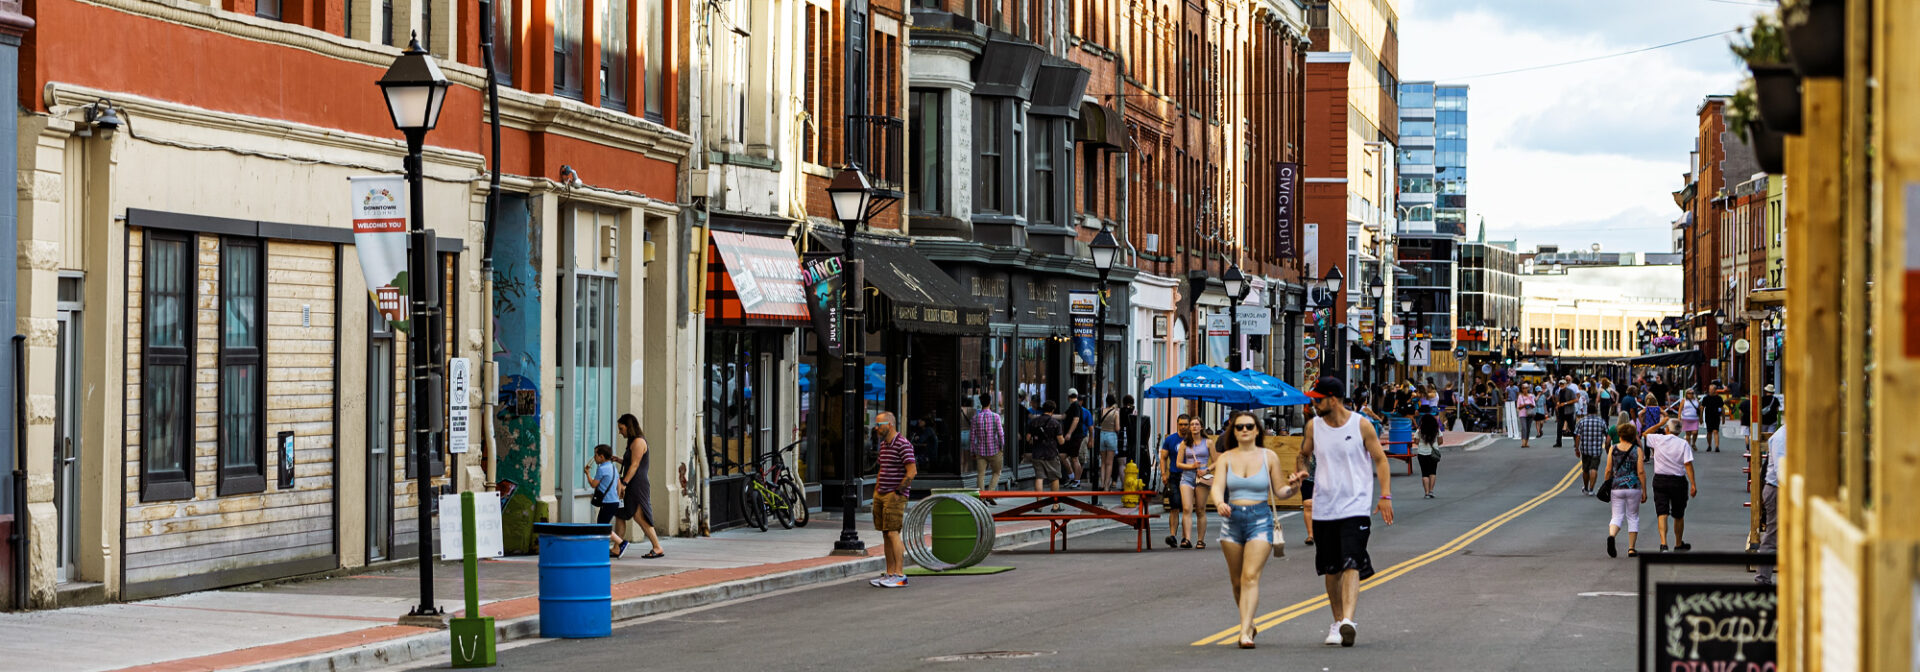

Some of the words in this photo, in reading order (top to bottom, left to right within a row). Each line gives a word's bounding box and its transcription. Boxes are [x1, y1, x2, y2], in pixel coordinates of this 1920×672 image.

[1279, 219, 1293, 255] DUTY
[803, 256, 843, 287] DANCE!
[807, 259, 818, 267] LET'S
[1179, 375, 1223, 385] Coors
[1685, 610, 1778, 661] papi
